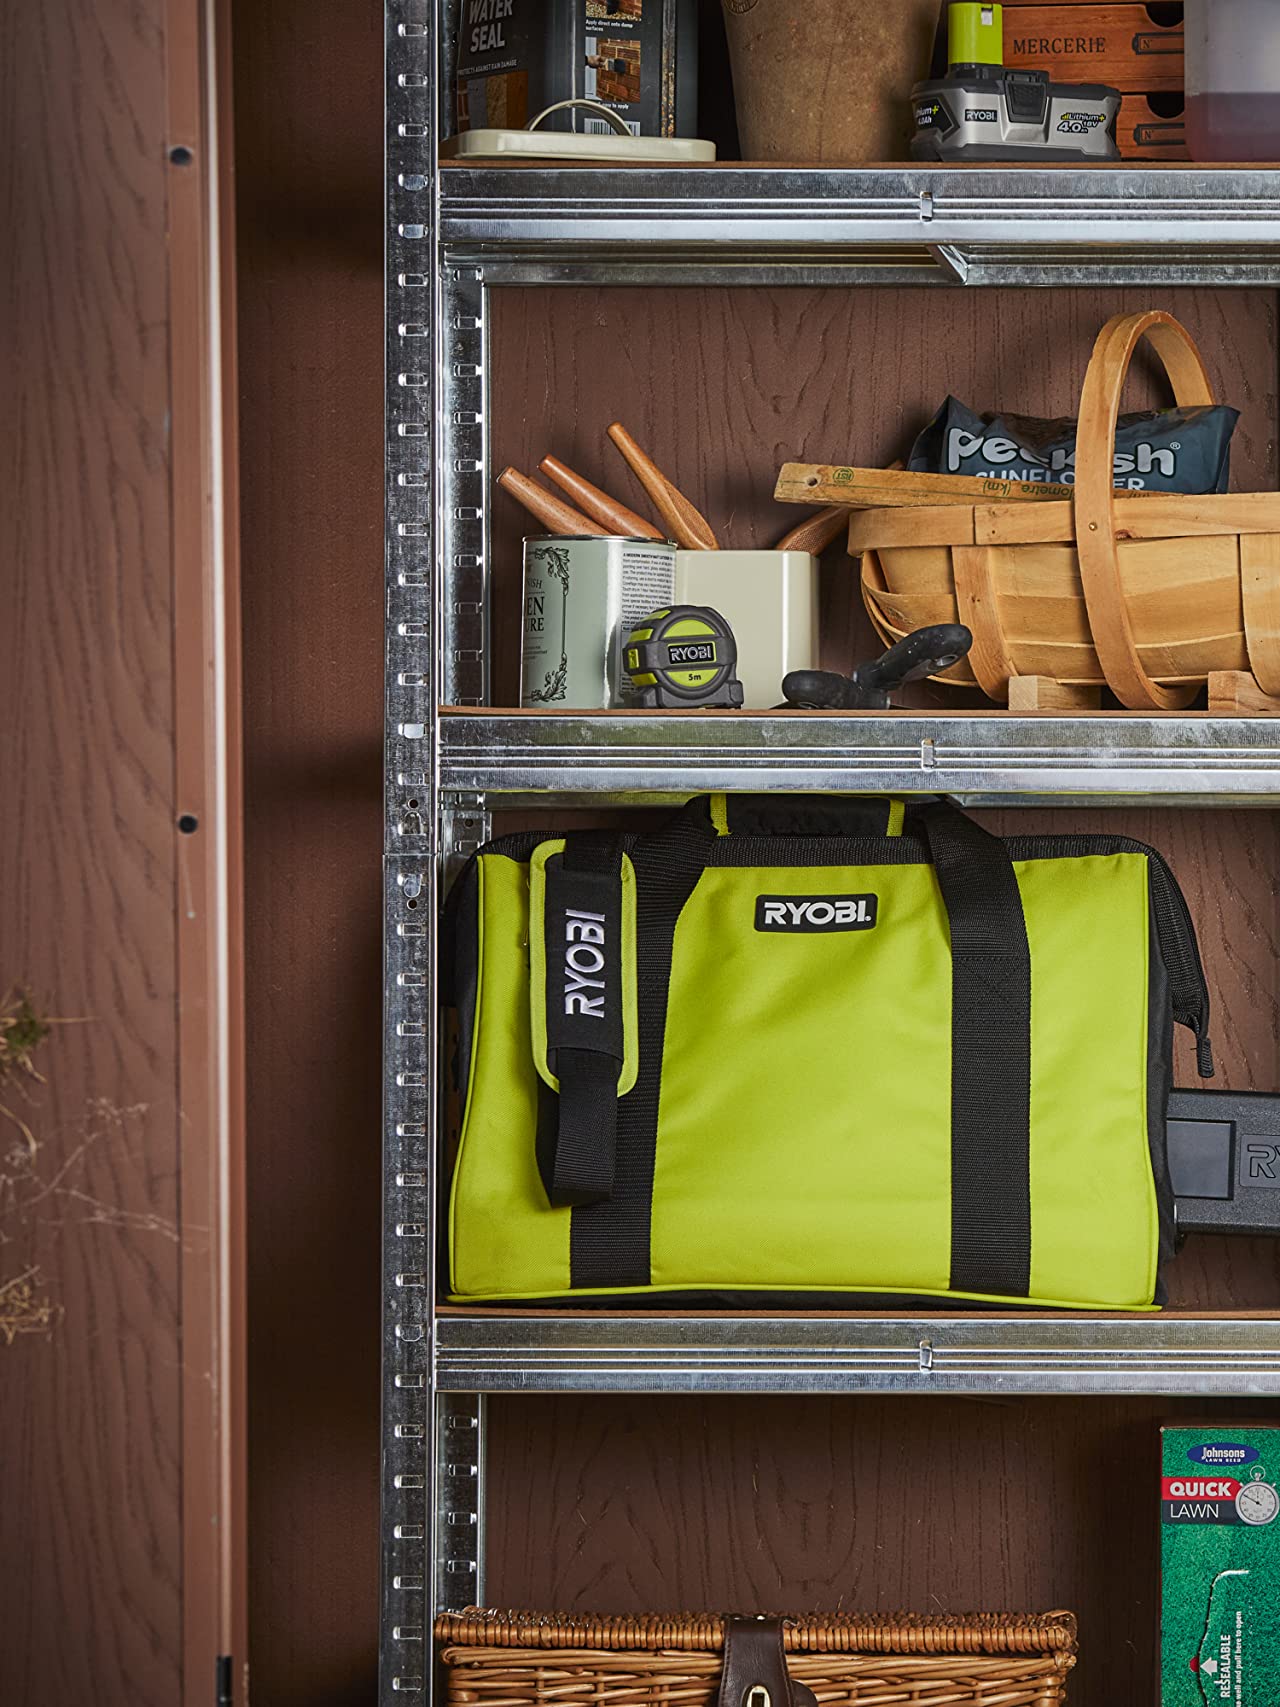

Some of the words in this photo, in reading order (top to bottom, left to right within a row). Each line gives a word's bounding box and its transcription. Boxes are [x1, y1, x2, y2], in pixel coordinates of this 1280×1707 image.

[469, 0, 513, 25] WATER
[470, 22, 505, 52] SEAL
[1013, 37, 1106, 54] MERCERIE
[982, 479, 1012, 497] (km)
[669, 645, 712, 661] RYOBI
[564, 908, 606, 1018] RYOBI
[1201, 1447, 1246, 1460] Johnsons
[1169, 1482, 1231, 1497] QUICK
[1170, 1503, 1219, 1518] LAWN
[1235, 1611, 1243, 1629] open
[1235, 1629, 1242, 1637] to
[1234, 1637, 1242, 1654] here
[1220, 1634, 1231, 1698] RESEALABLE
[1234, 1655, 1243, 1669] pull
[1234, 1670, 1242, 1684] and
